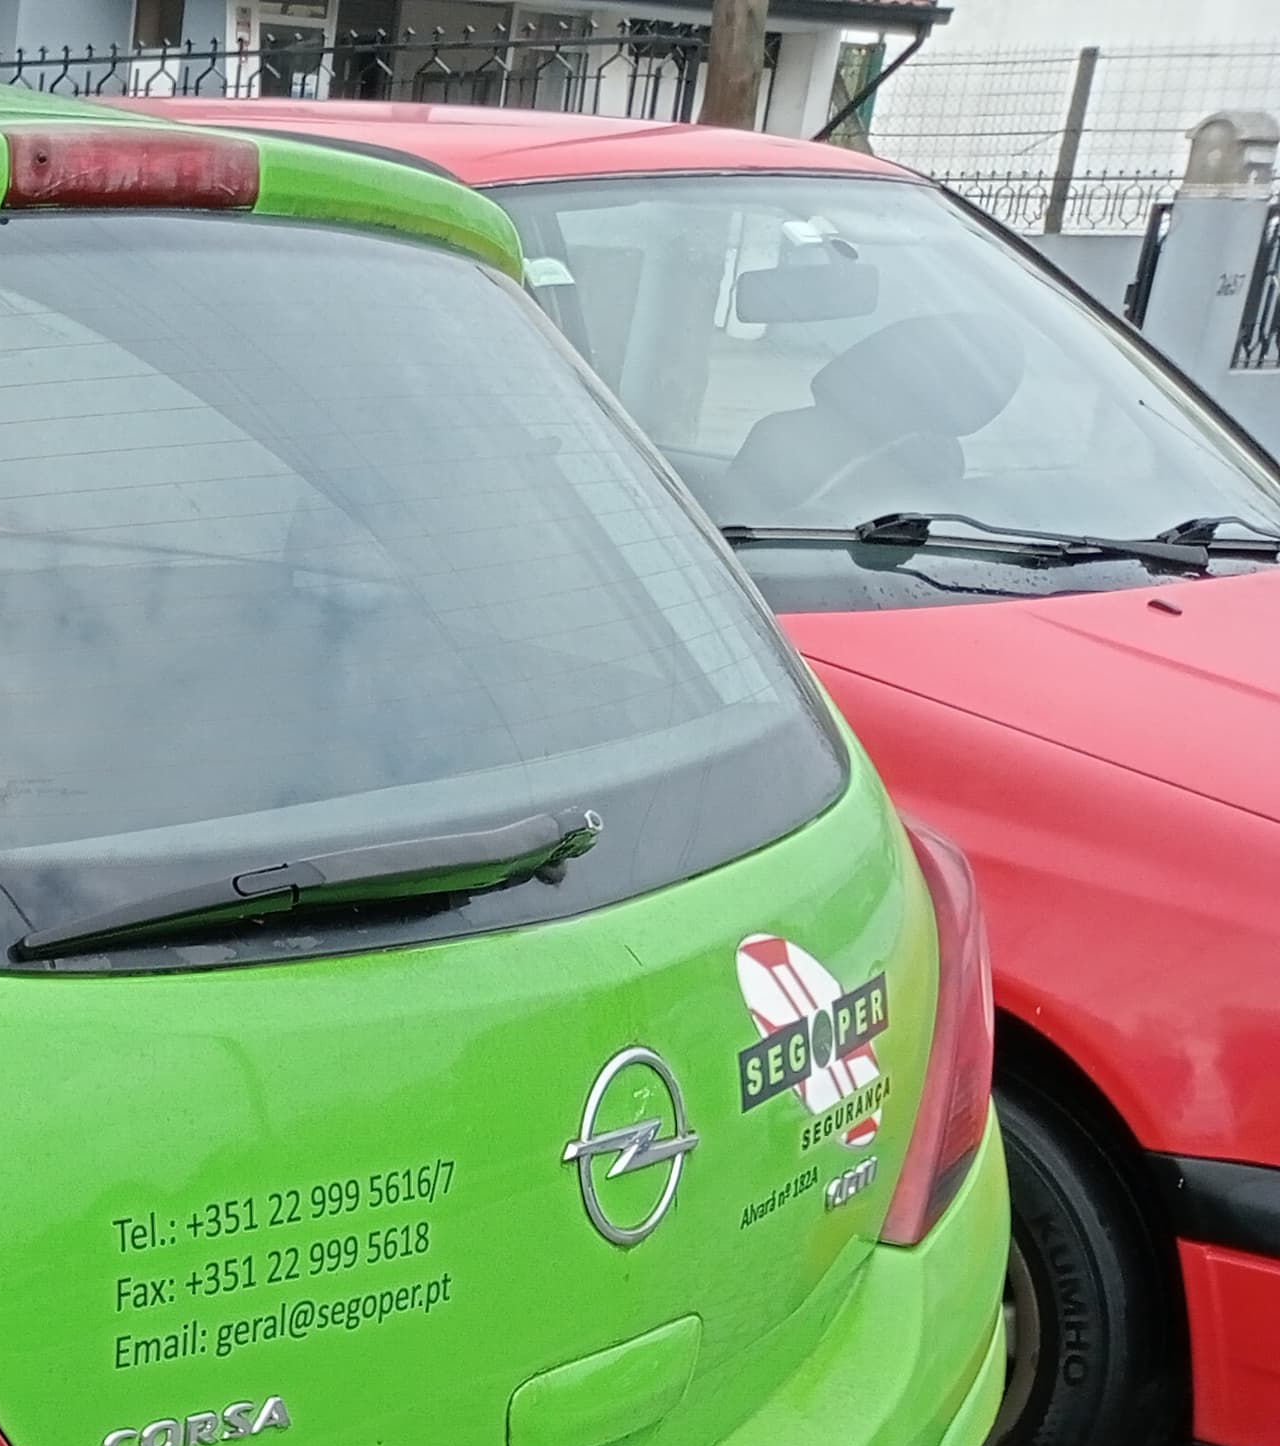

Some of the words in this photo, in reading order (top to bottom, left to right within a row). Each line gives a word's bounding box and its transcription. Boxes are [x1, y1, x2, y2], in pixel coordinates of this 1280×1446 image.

[801, 1076, 891, 1151] SEGURANÇA
[112, 1212, 177, 1254] Tel.:
[185, 1196, 258, 1239] +351
[268, 1190, 302, 1228] 22
[310, 1178, 361, 1219] 999
[369, 1159, 456, 1209] 5616/7
[740, 1190, 776, 1230] Alvará
[115, 1276, 176, 1313] Fax:
[185, 1255, 257, 1298] +351
[267, 1247, 300, 1284] 22
[309, 1235, 358, 1276] 999
[366, 1221, 430, 1265] 5618
[114, 1319, 208, 1369] Email:
[215, 1272, 452, 1358] geral@segoper.pt
